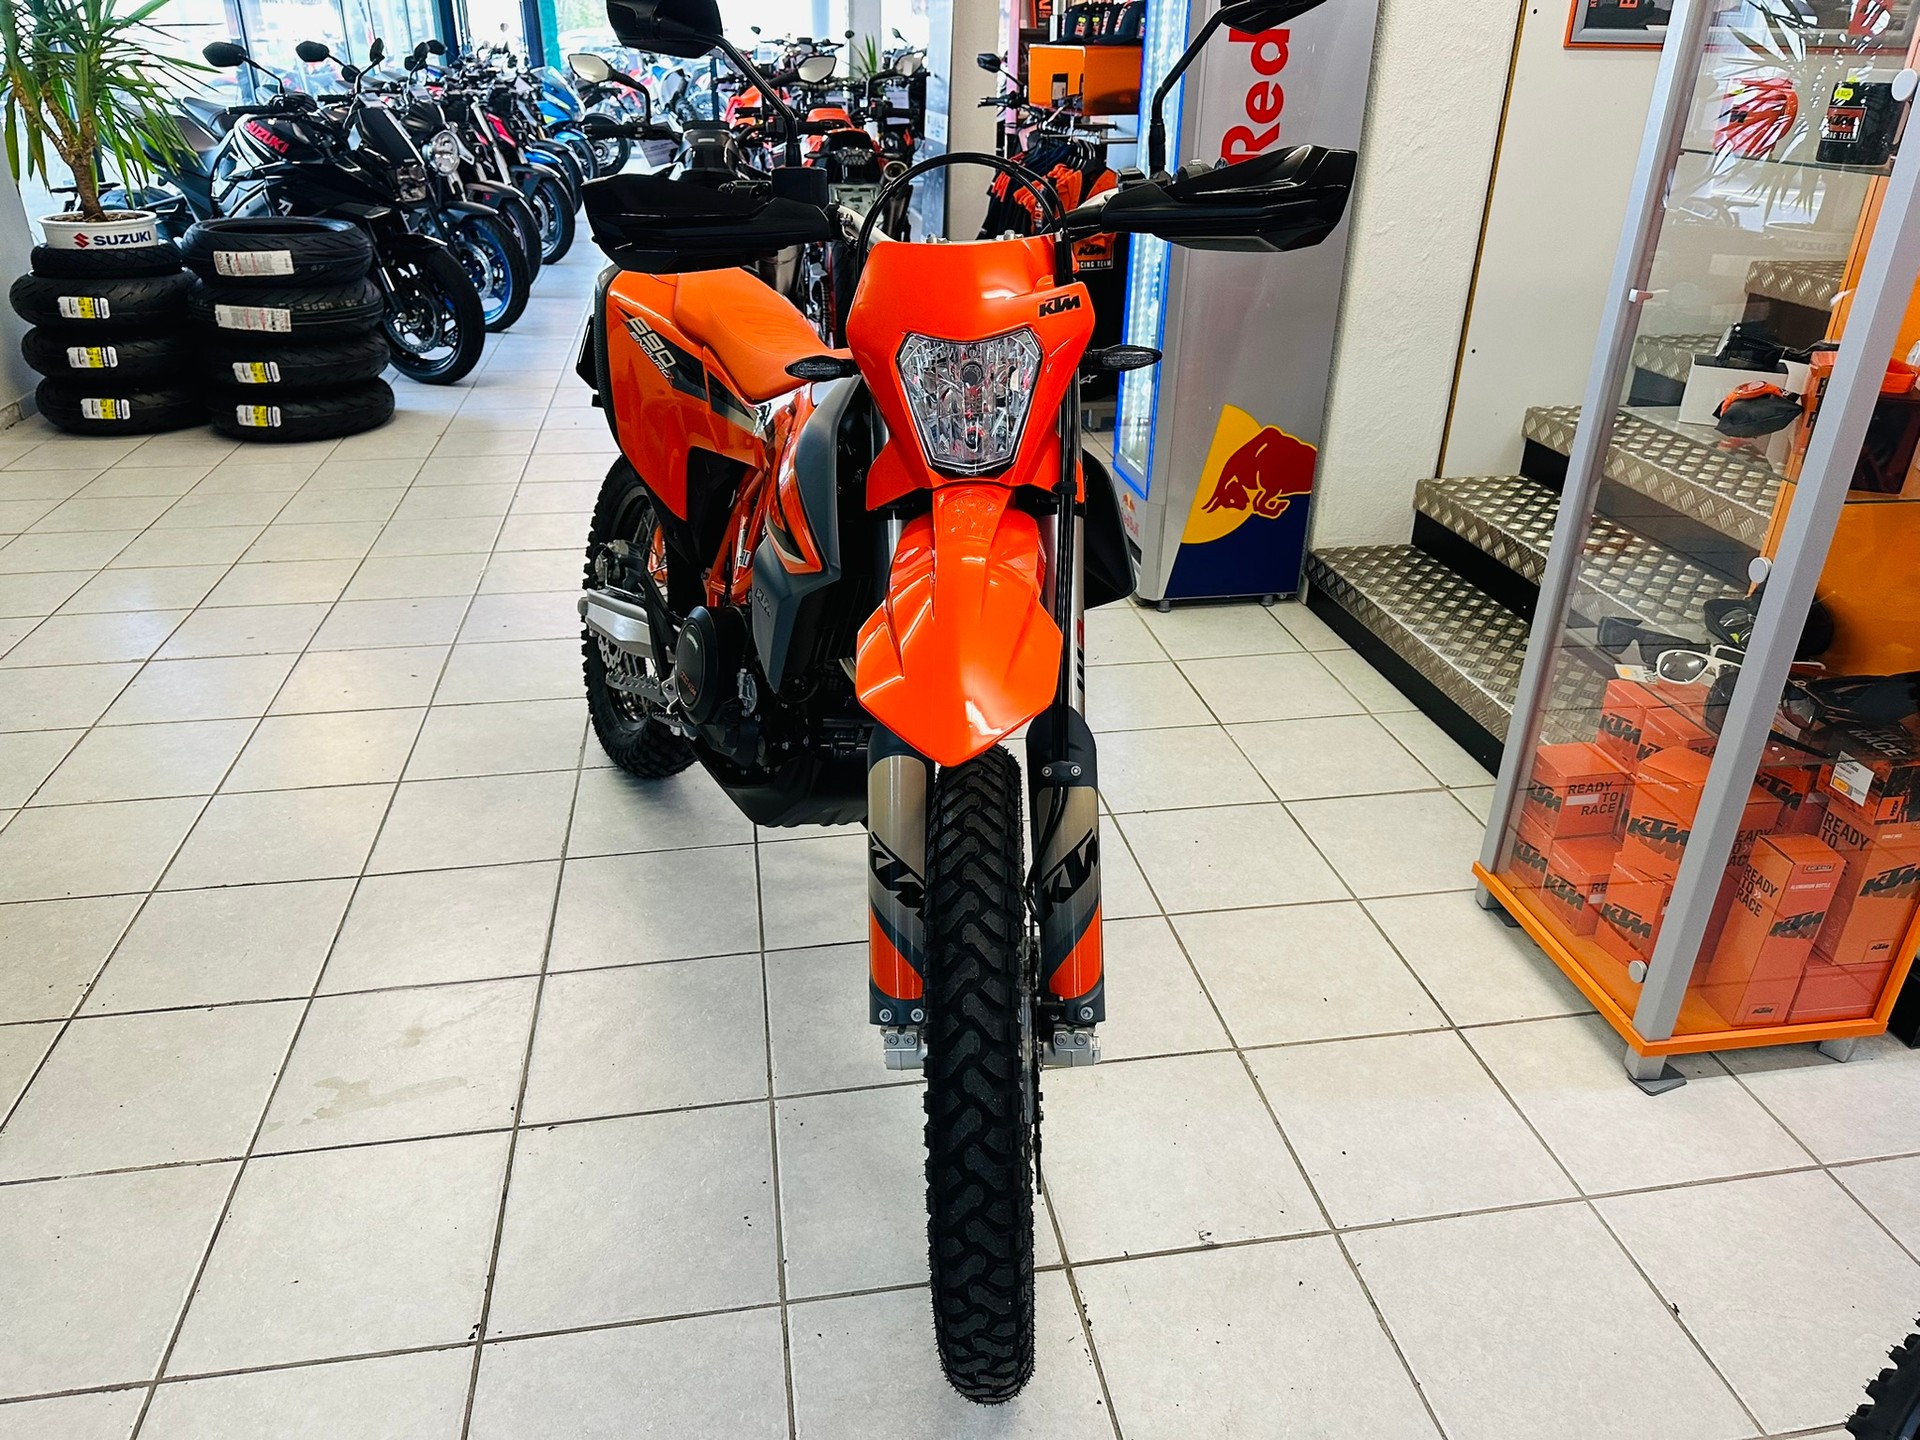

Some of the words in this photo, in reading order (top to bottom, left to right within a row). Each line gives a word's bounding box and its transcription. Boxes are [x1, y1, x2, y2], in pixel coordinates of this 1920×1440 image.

[1221, 27, 1290, 165] Red
[244, 120, 289, 153] SUZUKI
[93, 230, 152, 246] SUZUKI
[1039, 294, 1081, 317] KTM
[629, 315, 677, 369] 690
[1600, 713, 1642, 745] KTM
[1527, 780, 1563, 813] KTM
[1567, 781, 1613, 795] READY
[1602, 792, 1619, 803] TO
[1581, 803, 1616, 816] RACE
[1628, 816, 1691, 846] KTM
[1821, 826, 1839, 850] TO
[1823, 810, 1871, 851] READY
[1544, 874, 1585, 911] KTM
[1741, 877, 1754, 895] TO
[1743, 864, 1779, 898] READY
[1736, 888, 1763, 918] RACE
[1601, 903, 1653, 939] KTM
[1768, 911, 1826, 937] KTM
